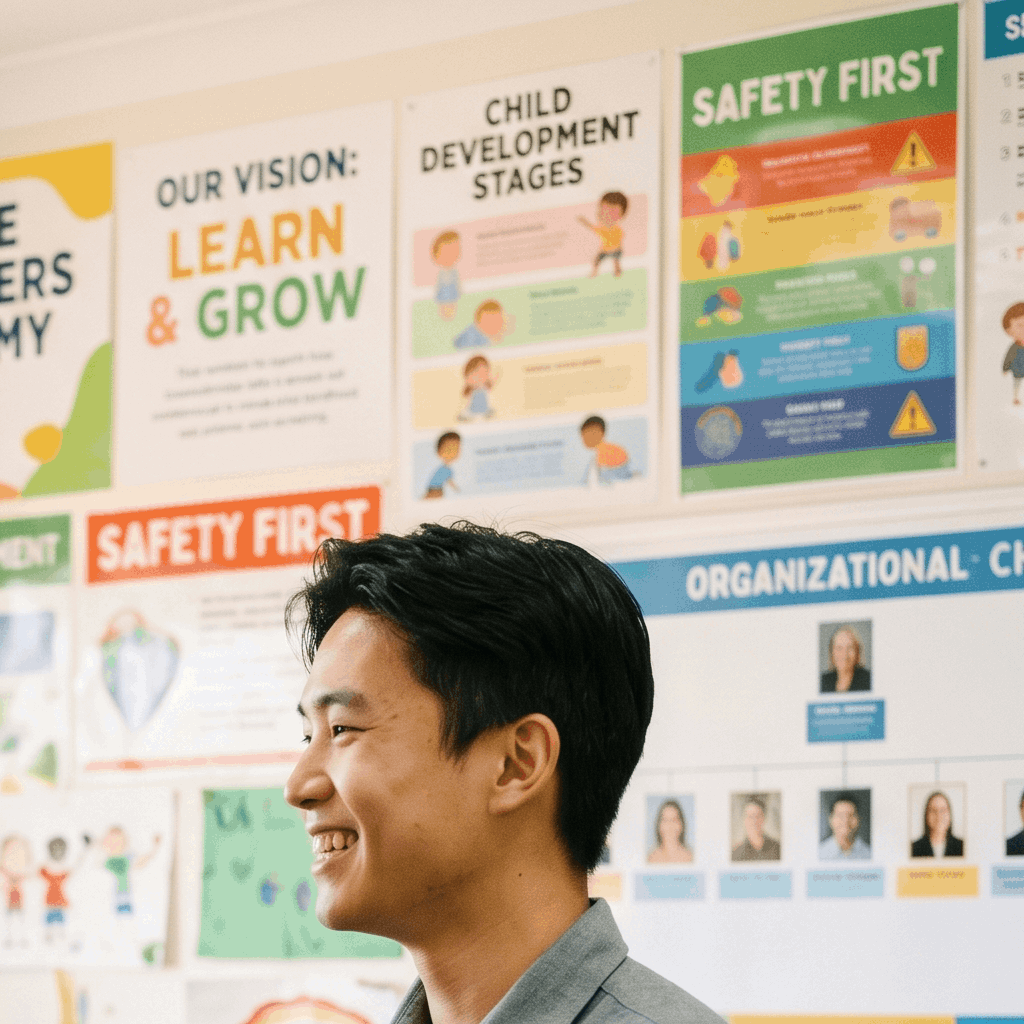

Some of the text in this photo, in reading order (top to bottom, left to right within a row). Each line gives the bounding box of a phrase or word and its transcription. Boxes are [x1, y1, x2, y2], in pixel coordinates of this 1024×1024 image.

[484, 87, 572, 127] CHILD
[692, 46, 943, 127] SAFETY FIRST
[421, 111, 640, 172] DEVELOPMENT
[157, 147, 359, 209] OUR VISION:
[472, 157, 584, 199] STAGES
[169, 204, 344, 280] LEARN
[146, 267, 367, 348] & GROW
[97, 499, 369, 571] SAFETY FIRST
[687, 545, 968, 601] ORGANIZATIONAL
